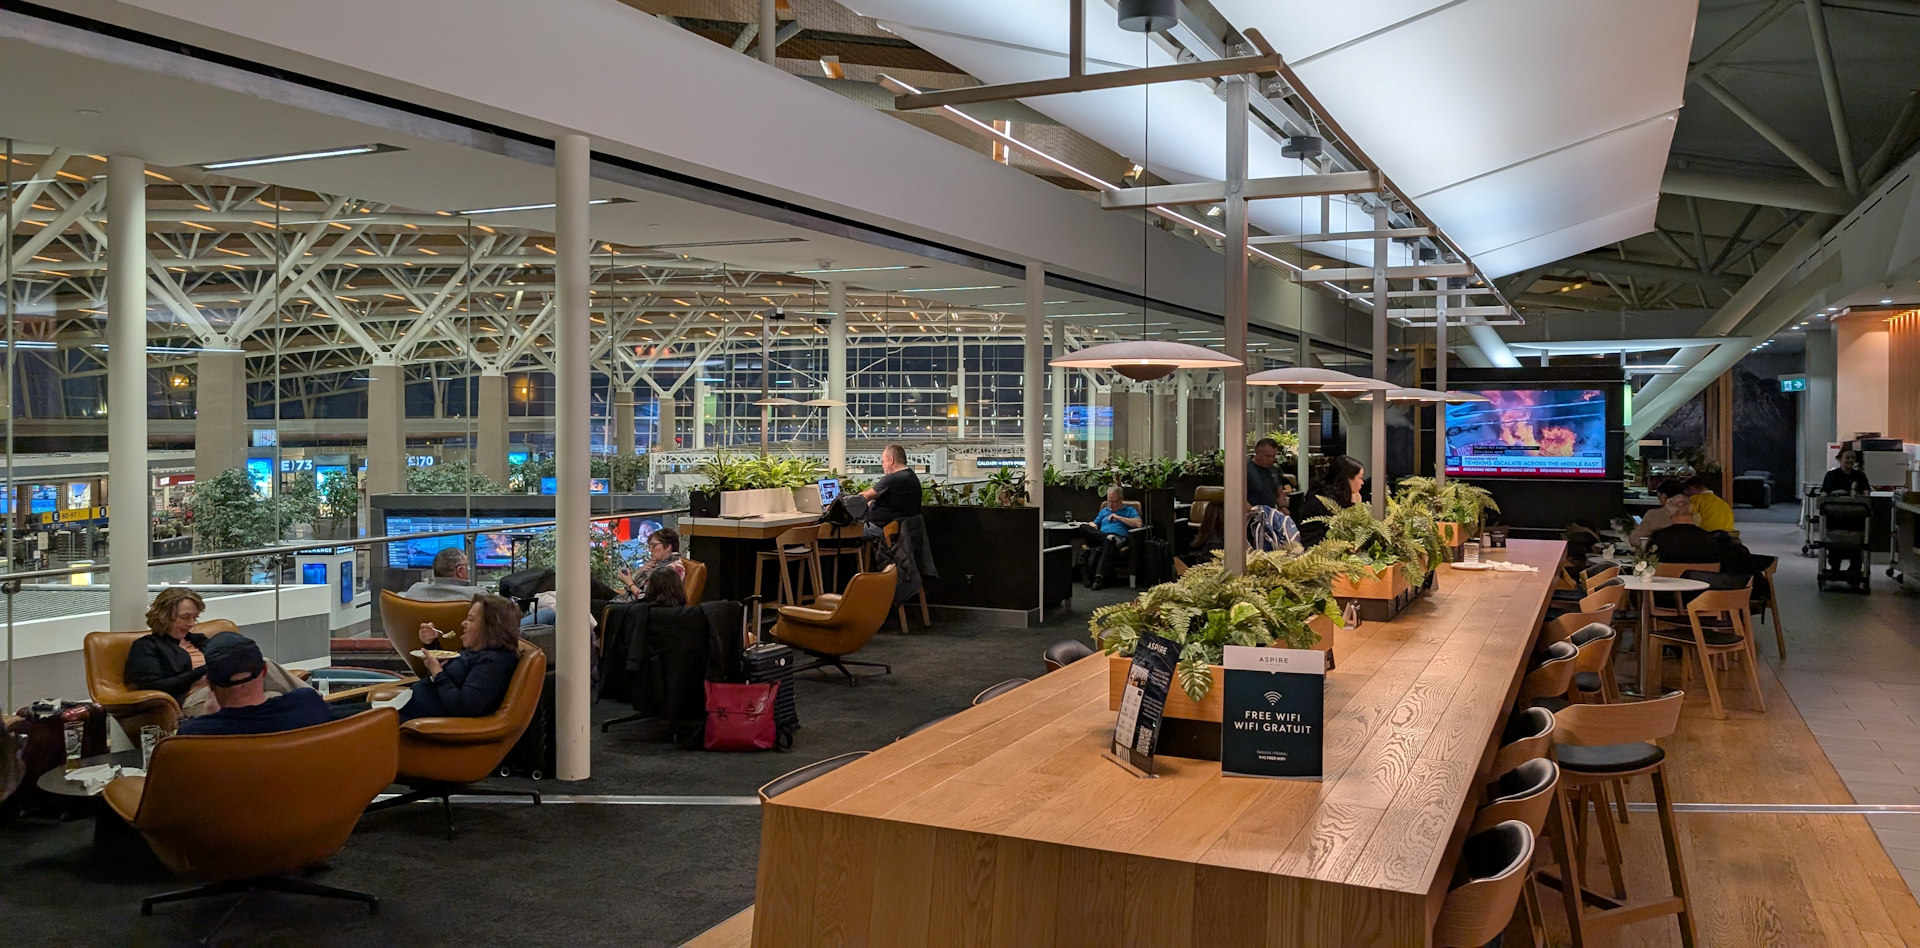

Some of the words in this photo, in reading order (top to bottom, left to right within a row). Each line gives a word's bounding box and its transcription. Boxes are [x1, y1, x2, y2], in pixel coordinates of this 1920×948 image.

[1147, 641, 1168, 655] ASPIRE
[1258, 656, 1289, 664] ASPIRE
[1244, 710, 1272, 720] FREE
[1275, 712, 1301, 722] WIFI
[1233, 720, 1259, 731] WIFI
[1262, 722, 1312, 734] GRATUIT
